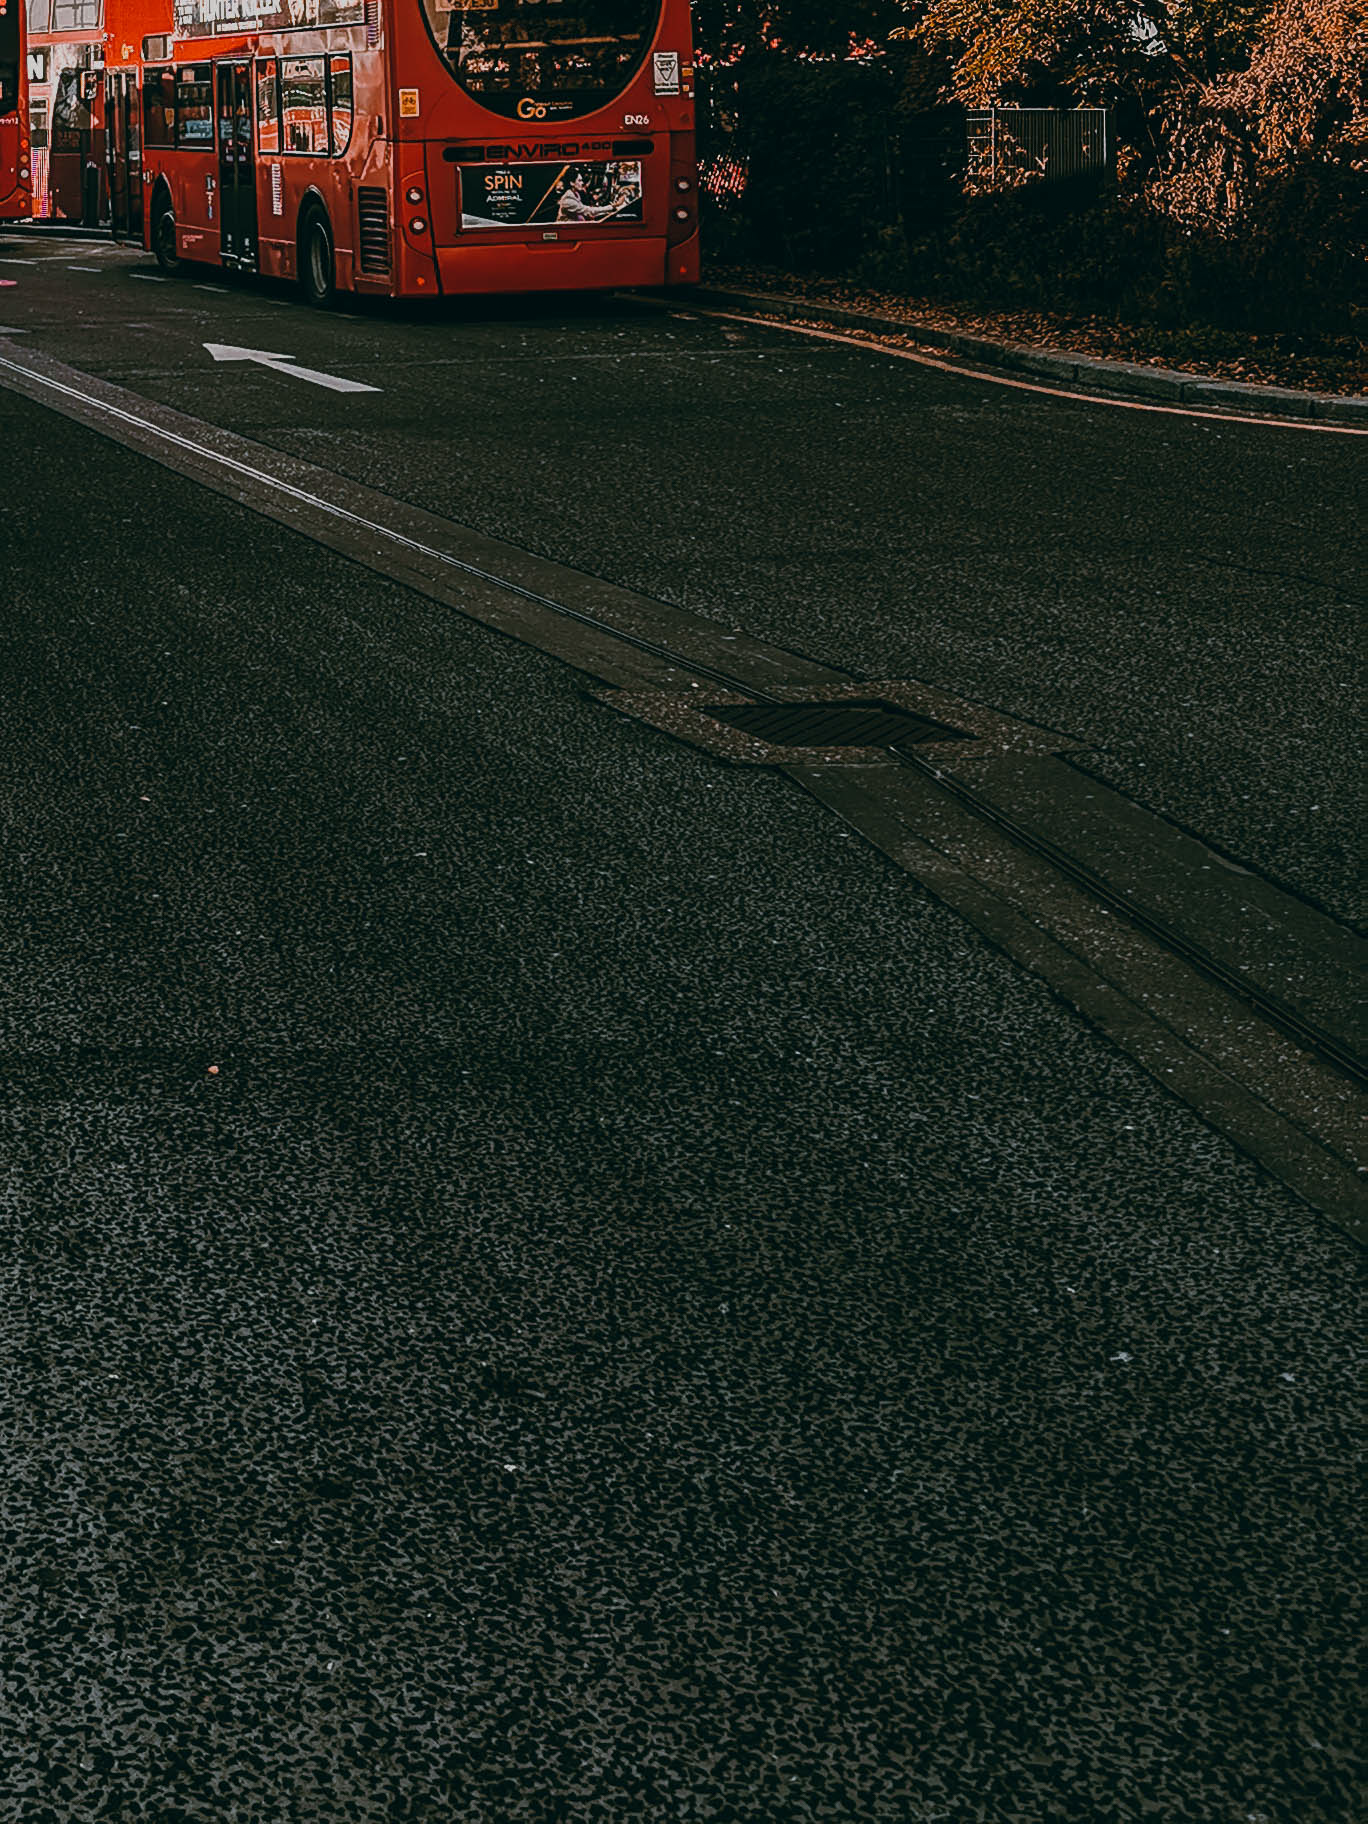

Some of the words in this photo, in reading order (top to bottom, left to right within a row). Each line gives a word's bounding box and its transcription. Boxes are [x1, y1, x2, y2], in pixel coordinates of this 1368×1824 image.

[517, 97, 547, 119] Go
[625, 114, 650, 125] EN26
[486, 142, 580, 159] ENVIRO
[484, 175, 523, 190] SPIN
[486, 194, 523, 203] ADMIRAL
